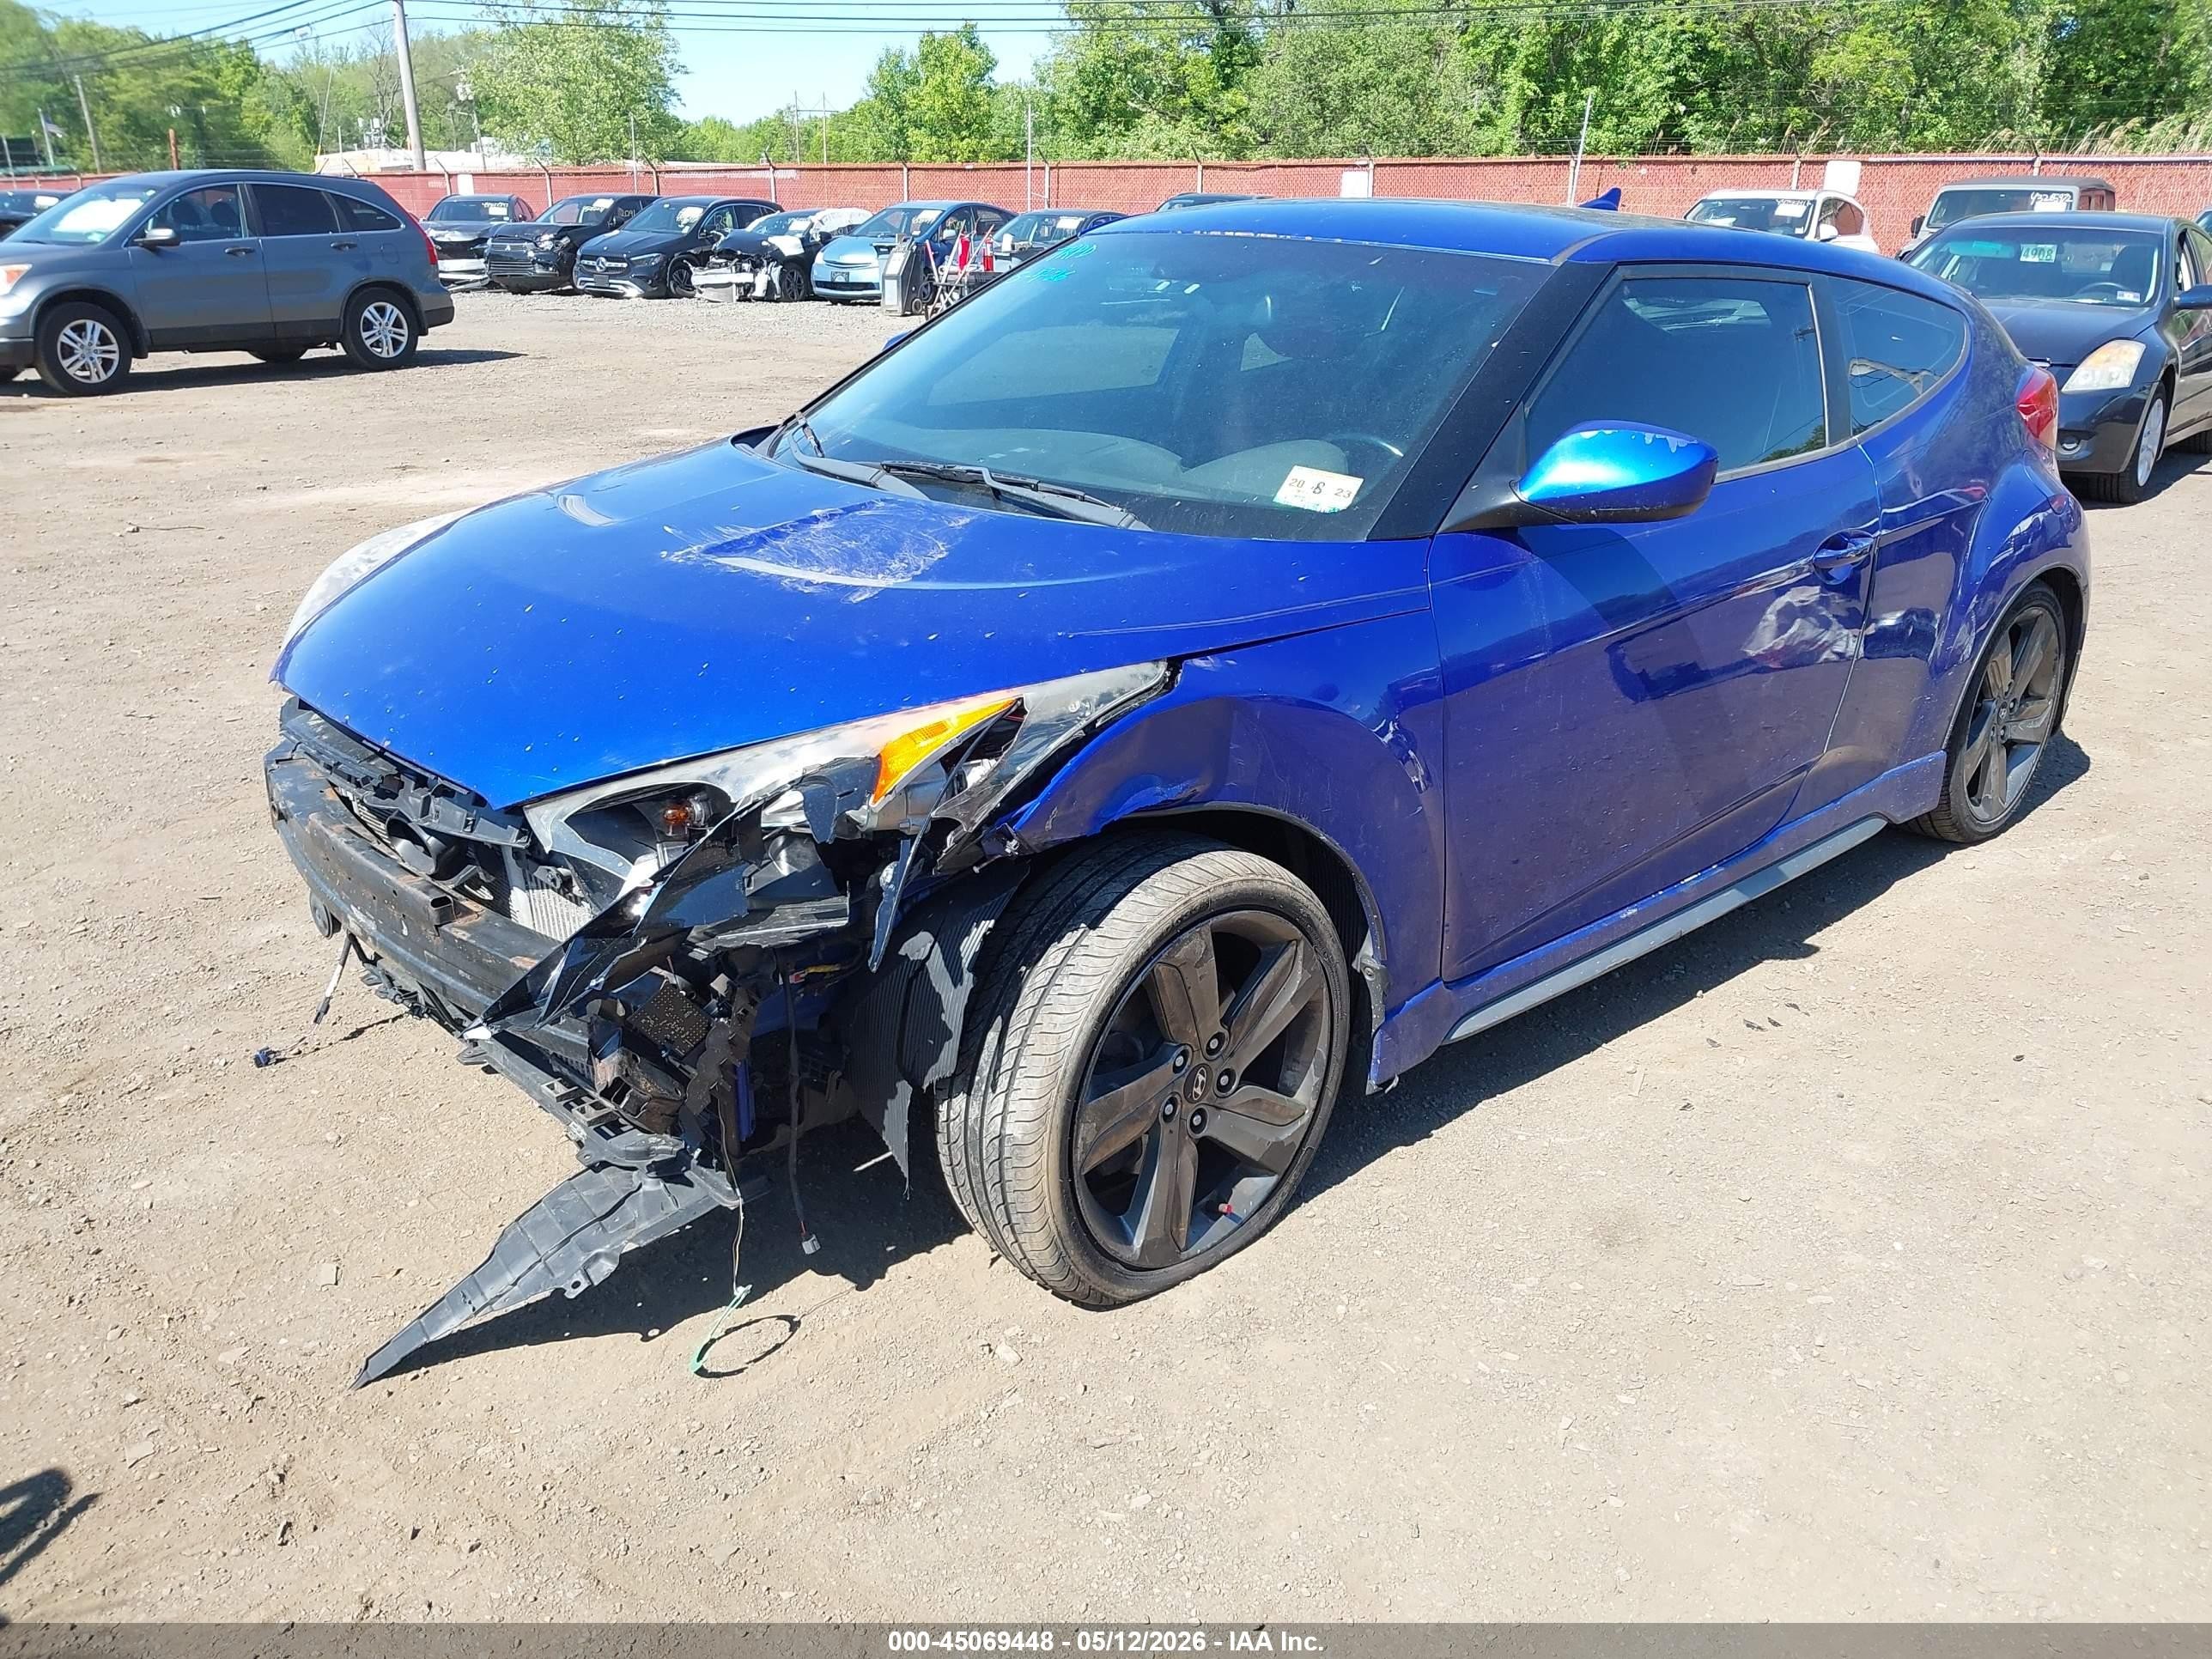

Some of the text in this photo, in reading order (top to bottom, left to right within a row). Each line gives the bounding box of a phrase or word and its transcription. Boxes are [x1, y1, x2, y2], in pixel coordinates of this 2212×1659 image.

[2022, 246, 2054, 261] 4908
[1289, 477, 1306, 489] 20
[1334, 488, 1352, 499] 23
